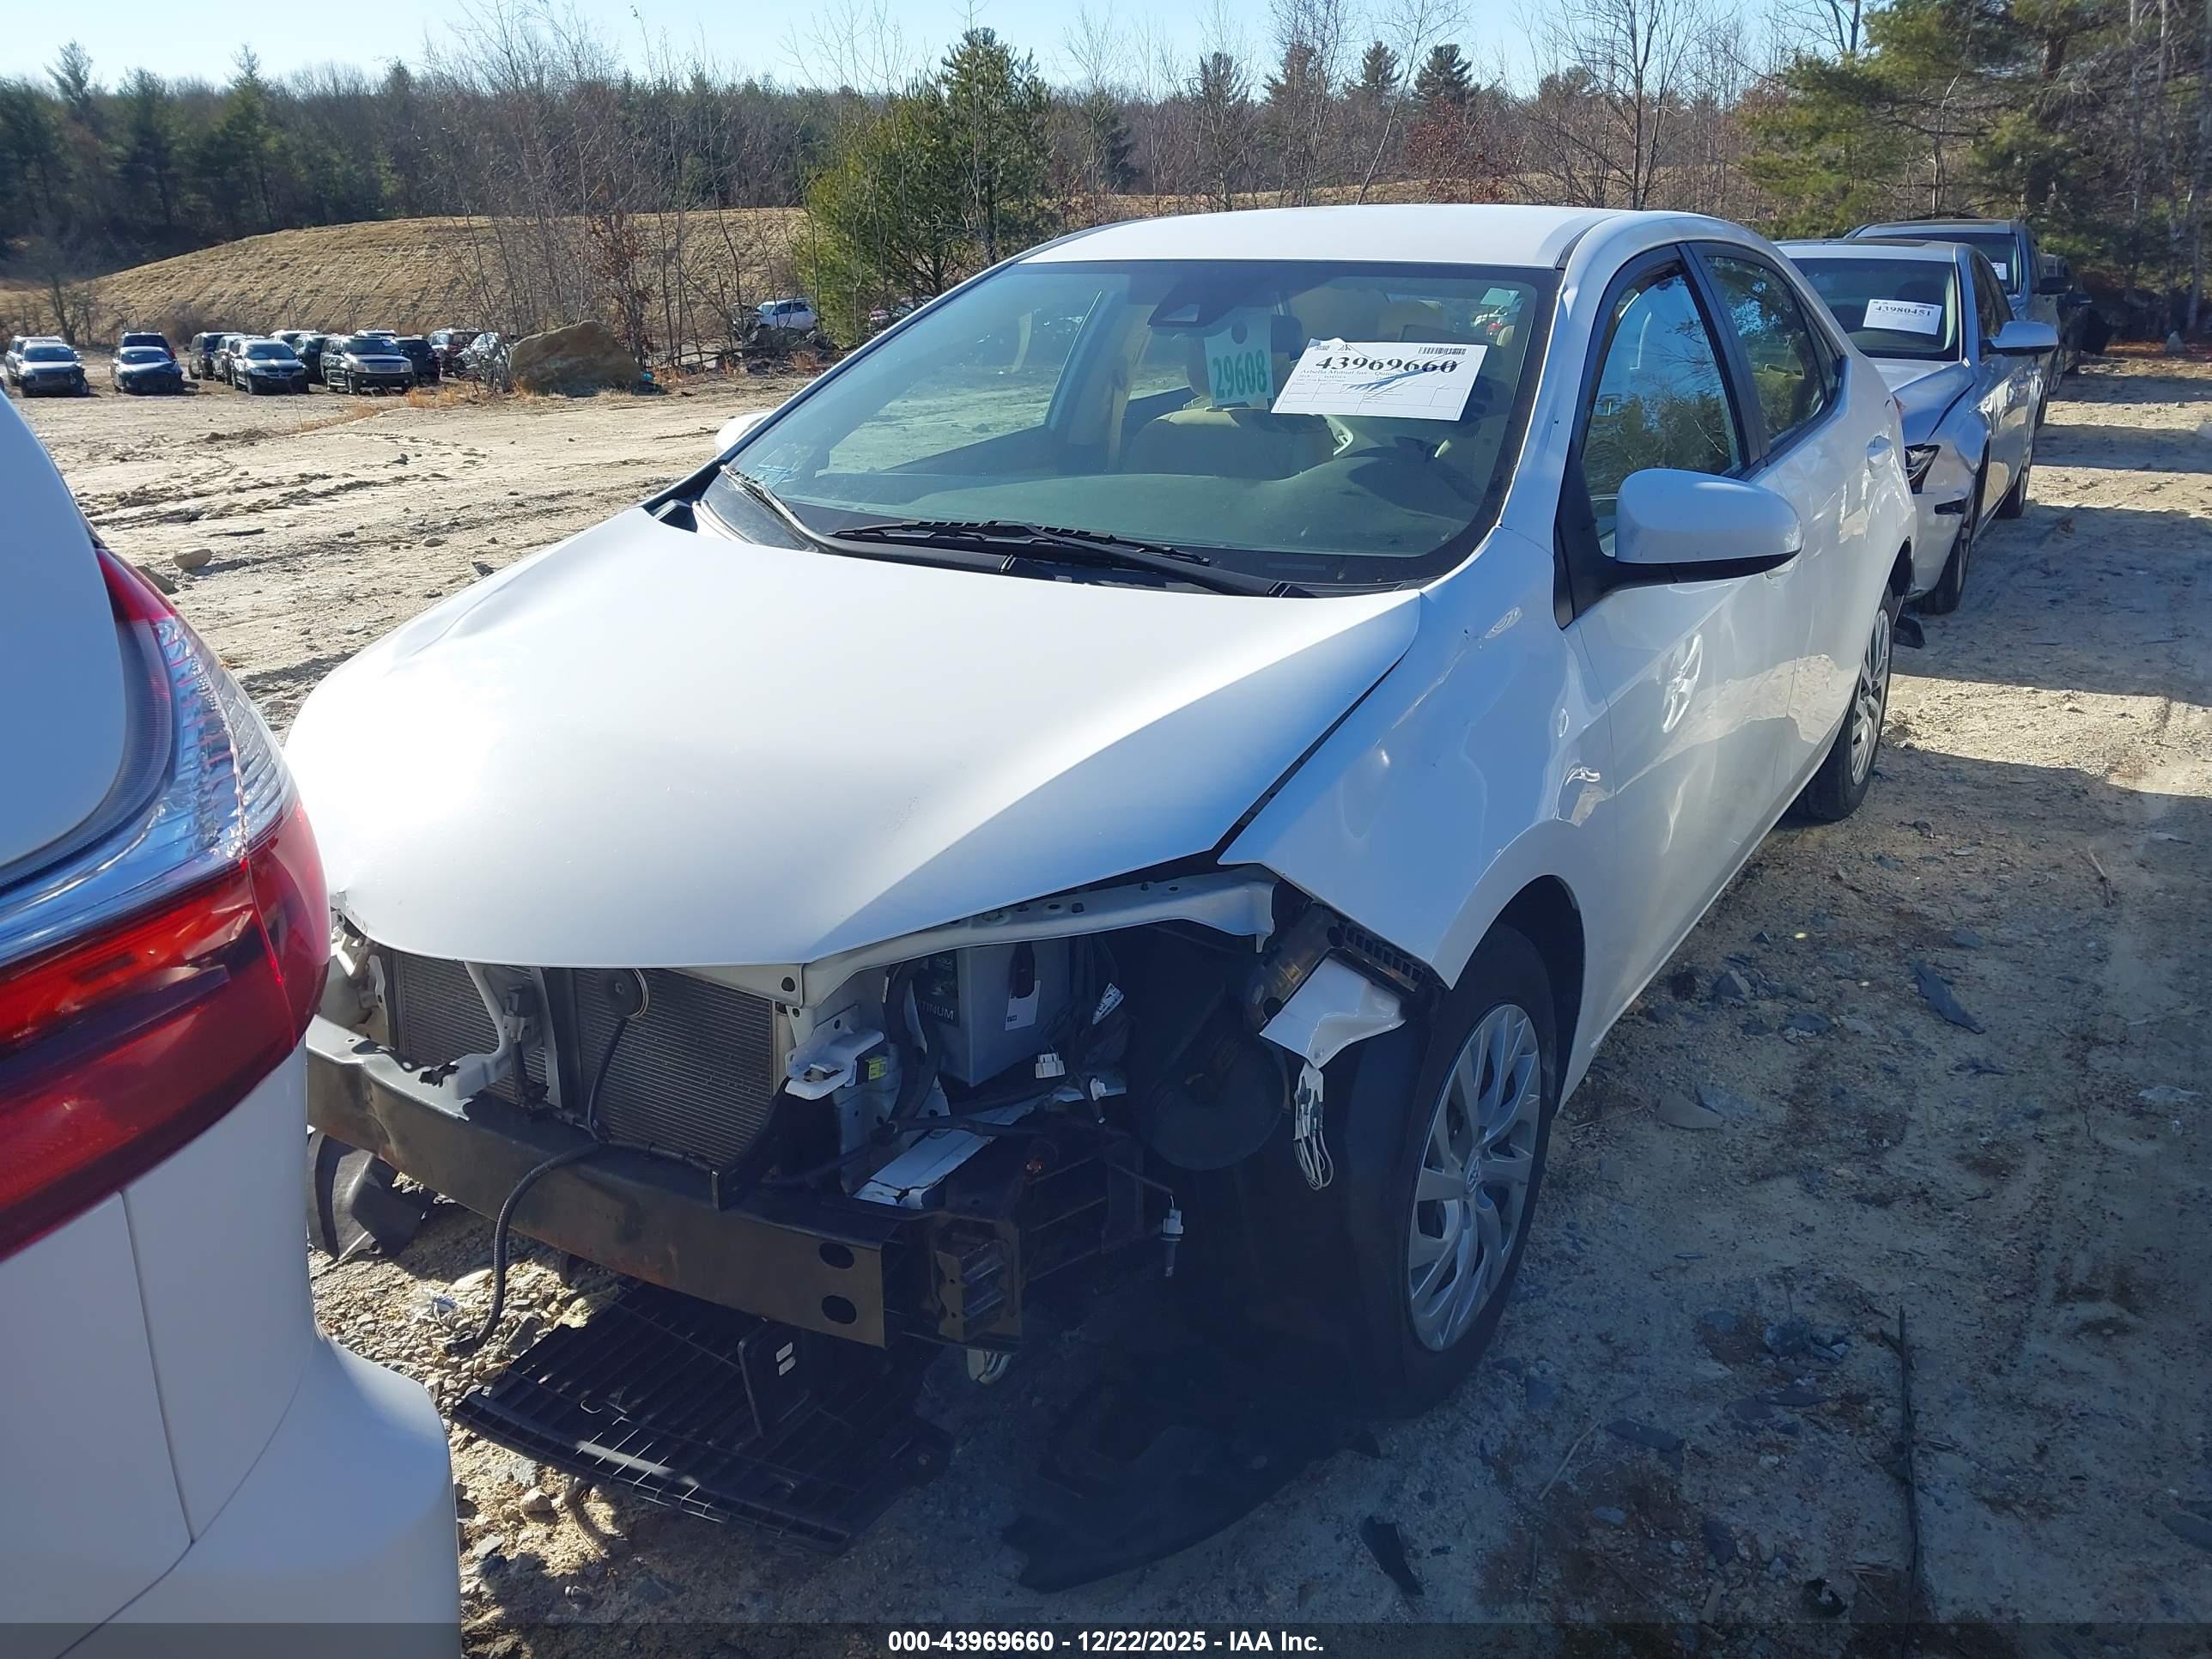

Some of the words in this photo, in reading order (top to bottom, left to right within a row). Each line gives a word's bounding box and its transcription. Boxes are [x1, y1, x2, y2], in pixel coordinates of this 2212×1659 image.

[1875, 305, 1930, 316] 43980451
[1212, 349, 1267, 399] 29608
[1316, 356, 1458, 374] 43969660
